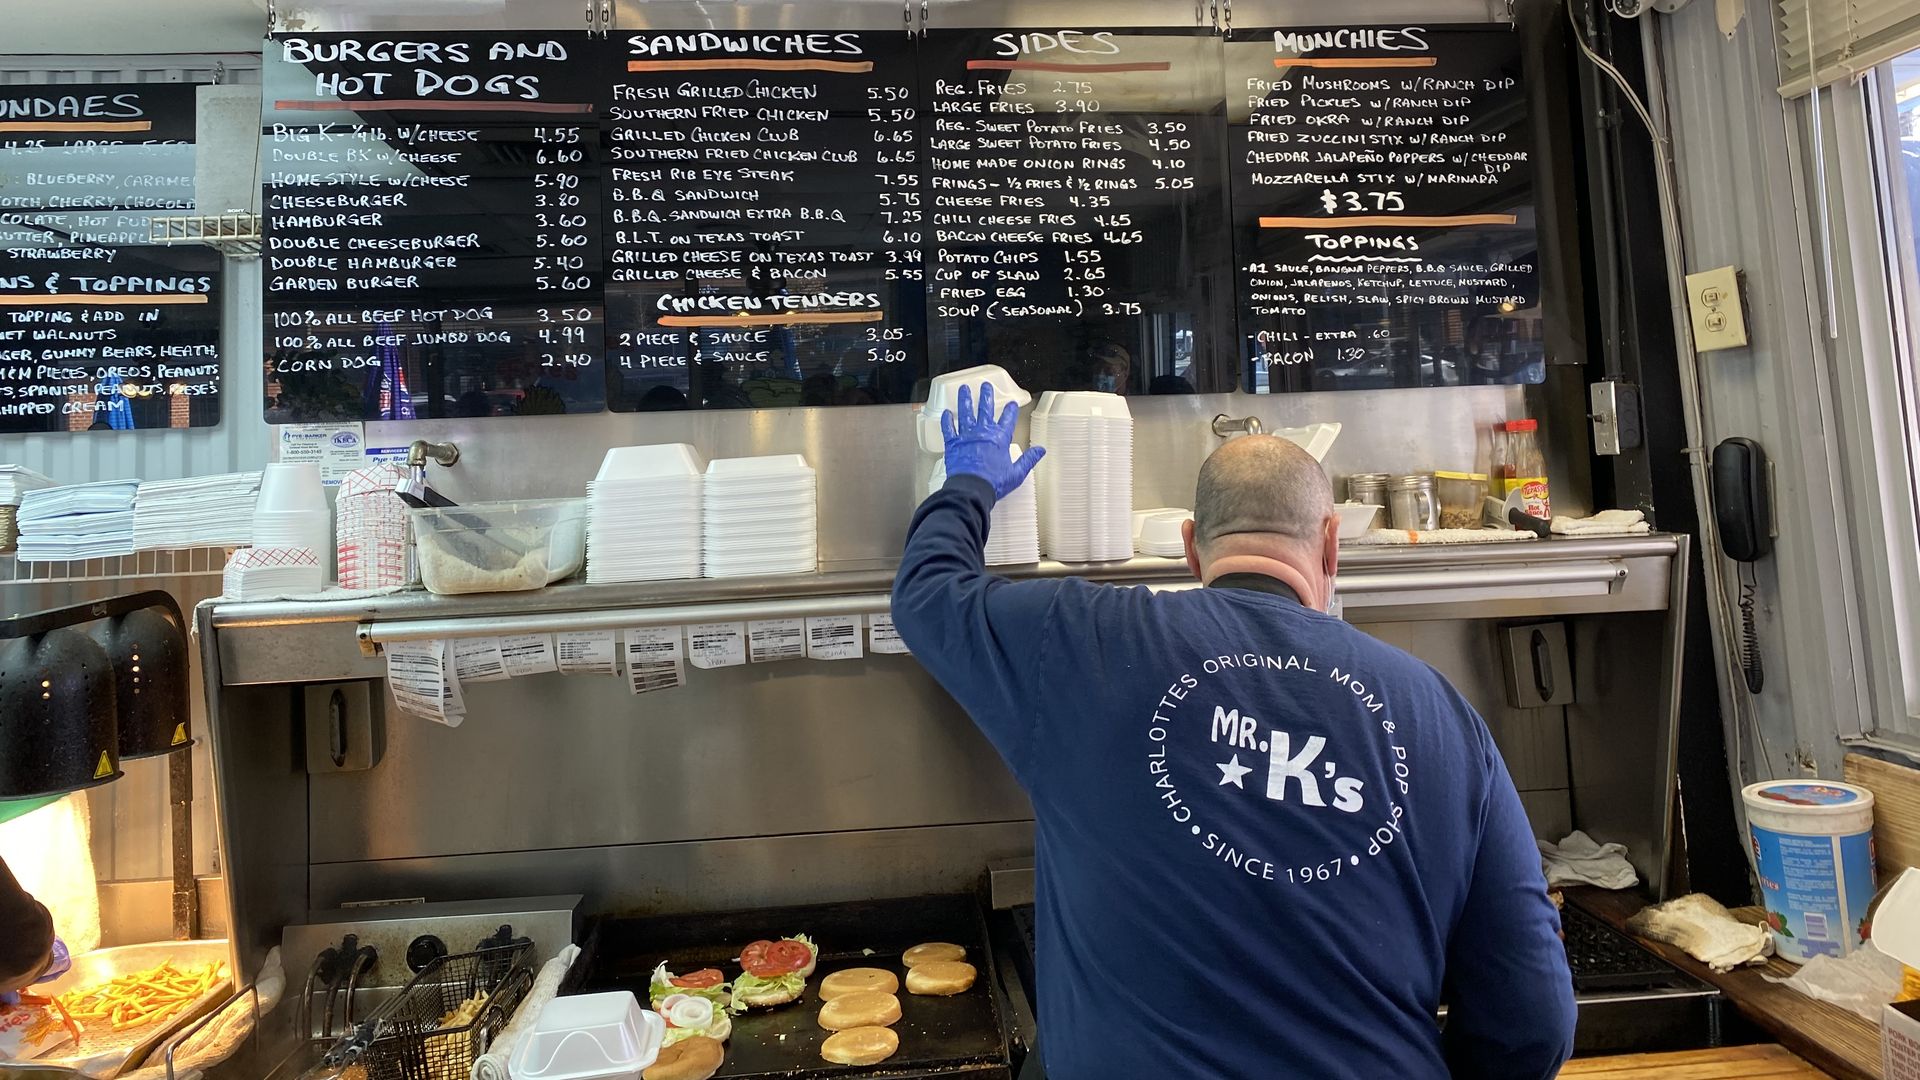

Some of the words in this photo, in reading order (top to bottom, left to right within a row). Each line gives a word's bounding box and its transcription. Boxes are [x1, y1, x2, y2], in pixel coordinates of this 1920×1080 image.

[628, 33, 862, 55] SANDWICHES
[993, 30, 1118, 55] SIDES
[1274, 27, 1429, 52] MUNCHIES
[283, 39, 469, 63] BURGERS
[489, 41, 567, 60] AND
[317, 73, 392, 95] HOT
[415, 69, 539, 99] DOGS
[613, 84, 669, 100] FRESH
[677, 82, 743, 98] GRILLED
[746, 79, 816, 99] CHICKEN
[868, 87, 908, 101] 5.50
[978, 80, 1026, 95] FRIES
[1053, 81, 1092, 94] 2.75
[1248, 78, 1292, 91] FRIED
[1303, 75, 1390, 91] MUSHROOMS
[933, 102, 981, 113] LARGE
[990, 102, 1034, 114] FRIES
[1056, 100, 1099, 113] 3.90
[1301, 94, 1361, 107] PICKLES
[610, 107, 696, 120] SOUTHERN
[702, 106, 748, 118] FRIED
[757, 108, 828, 121] CHICKEN
[868, 108, 915, 122] 5.50
[1306, 114, 1350, 126] OKRA
[611, 127, 685, 141] GRILLED
[691, 127, 750, 142] CHICKEN
[757, 127, 799, 142] CLUB
[874, 130, 912, 142] 6.65
[976, 120, 1021, 132] SWEET
[1027, 119, 1073, 134] POTATO
[1080, 121, 1123, 134] FRIES
[1148, 122, 1186, 134] 3.50
[1371, 135, 1403, 145] STIX
[611, 147, 698, 159] SOUTHERN
[706, 149, 749, 159] FRIED
[753, 149, 817, 161] CHICKEN
[822, 150, 857, 162] CLUB
[877, 151, 915, 163] 6.65
[1246, 150, 1309, 163] CHEDDAR
[1389, 153, 1445, 163] POPPERS
[932, 157, 970, 170] HOME
[976, 158, 1017, 168] MADE
[1024, 159, 1074, 169] ONION
[1083, 158, 1125, 169] RINGS
[1152, 159, 1185, 169] 4.10
[612, 168, 661, 181] FRESH
[671, 168, 696, 180] RIB
[703, 170, 732, 181] EYE
[737, 168, 794, 181] STEAK
[875, 174, 918, 186] 7.55
[1252, 173, 1349, 184] MOZZARELLA
[1357, 174, 1395, 184] STIX
[270, 193, 407, 209] CHEESEBURGER
[536, 193, 579, 206] 3.80
[675, 189, 758, 201] SANDWICH
[880, 192, 920, 205] 5.75
[936, 196, 992, 206] CHEESE
[1000, 195, 1045, 207] FRIES
[1070, 196, 1110, 207] 4.35
[1320, 189, 1404, 214] $3.75
[272, 213, 382, 230] HAMBURGER
[536, 214, 586, 227] 3.60
[269, 237, 340, 249] DOUBLE
[348, 233, 480, 250] CHEESEBURGER
[537, 234, 587, 247] 5.60
[670, 235, 690, 244] ON
[694, 233, 744, 243] TEXAS
[750, 231, 804, 241] TOAST
[883, 231, 921, 243] 6.10
[937, 230, 986, 241] BACON
[991, 231, 1043, 242] CHEESE
[1052, 232, 1092, 244] FRIES
[1305, 235, 1419, 250] TOPPINGS
[7, 246, 116, 262] STRAWBERRY
[938, 249, 989, 263] POTATO
[994, 251, 1038, 264] CHIPS
[1065, 250, 1101, 263] 1.55
[271, 256, 337, 270] DOUBLE
[348, 256, 456, 269] HAMBURGER
[534, 256, 583, 270] 5.40
[935, 268, 962, 280] CUP
[972, 270, 990, 279] OF
[997, 270, 1039, 280] SLAW
[1064, 267, 1105, 280] 2.65
[67, 276, 210, 294] TOPPINGS
[269, 276, 337, 291] GARDEN
[347, 276, 419, 289] BURGER
[536, 276, 590, 290] 5.60
[941, 288, 985, 298] FRIED
[996, 287, 1025, 297] EGG
[1068, 285, 1104, 297] 1.30
[657, 294, 761, 310] CHICKEN
[765, 292, 880, 310] TENDERS
[1429, 295, 1469, 304] BROWN
[7, 310, 73, 323] TOPPING
[93, 311, 124, 321] ADD
[139, 309, 159, 321] IN
[274, 310, 321, 328] 100%
[326, 313, 357, 325] ALL
[362, 309, 405, 323] BEEF
[411, 309, 448, 322] HOT
[451, 307, 492, 320] DOG
[537, 308, 591, 322] 3.50
[938, 304, 979, 317] SOUP
[1251, 306, 1305, 315] TOMATO
[33, 329, 116, 340] WALNUTS
[275, 336, 322, 349] 100%
[327, 338, 355, 347] ALL
[363, 334, 406, 346] BEEF
[412, 332, 468, 345] JUMBO
[476, 331, 510, 343] DOG
[539, 327, 584, 343] 4.99
[620, 333, 630, 346] 2
[637, 333, 679, 345] PIECE
[709, 330, 770, 344] SAUCE
[1257, 331, 1298, 345] CHILI
[1316, 331, 1356, 340] EXTRA
[42, 348, 96, 360] GUMMY
[103, 346, 156, 358] BEARS,
[161, 345, 218, 358] HEATH,
[620, 356, 631, 368] 4
[640, 355, 686, 368] PIECE
[713, 351, 769, 361] SAUCE
[868, 349, 906, 362] 5.60
[1262, 347, 1313, 369] BACON
[1338, 348, 1365, 361] 1.30
[277, 360, 332, 372] CORN
[341, 356, 381, 368] DOG
[541, 354, 591, 367] 2.40
[18, 384, 88, 397] SPANISH
[62, 400, 123, 417] CREAM
[1203, 654, 1317, 674] ORIGINAL
[1330, 667, 1384, 712] MOM
[1211, 705, 1268, 752] MR.
[1382, 720, 1395, 734] &
[1149, 674, 1198, 822] CHARLOTTES
[1266, 730, 1364, 812] K's
[1392, 745, 1408, 794] POP
[1368, 802, 1403, 856] SHOP
[1202, 833, 1274, 880] SINCE
[1287, 858, 1342, 883] 1967
